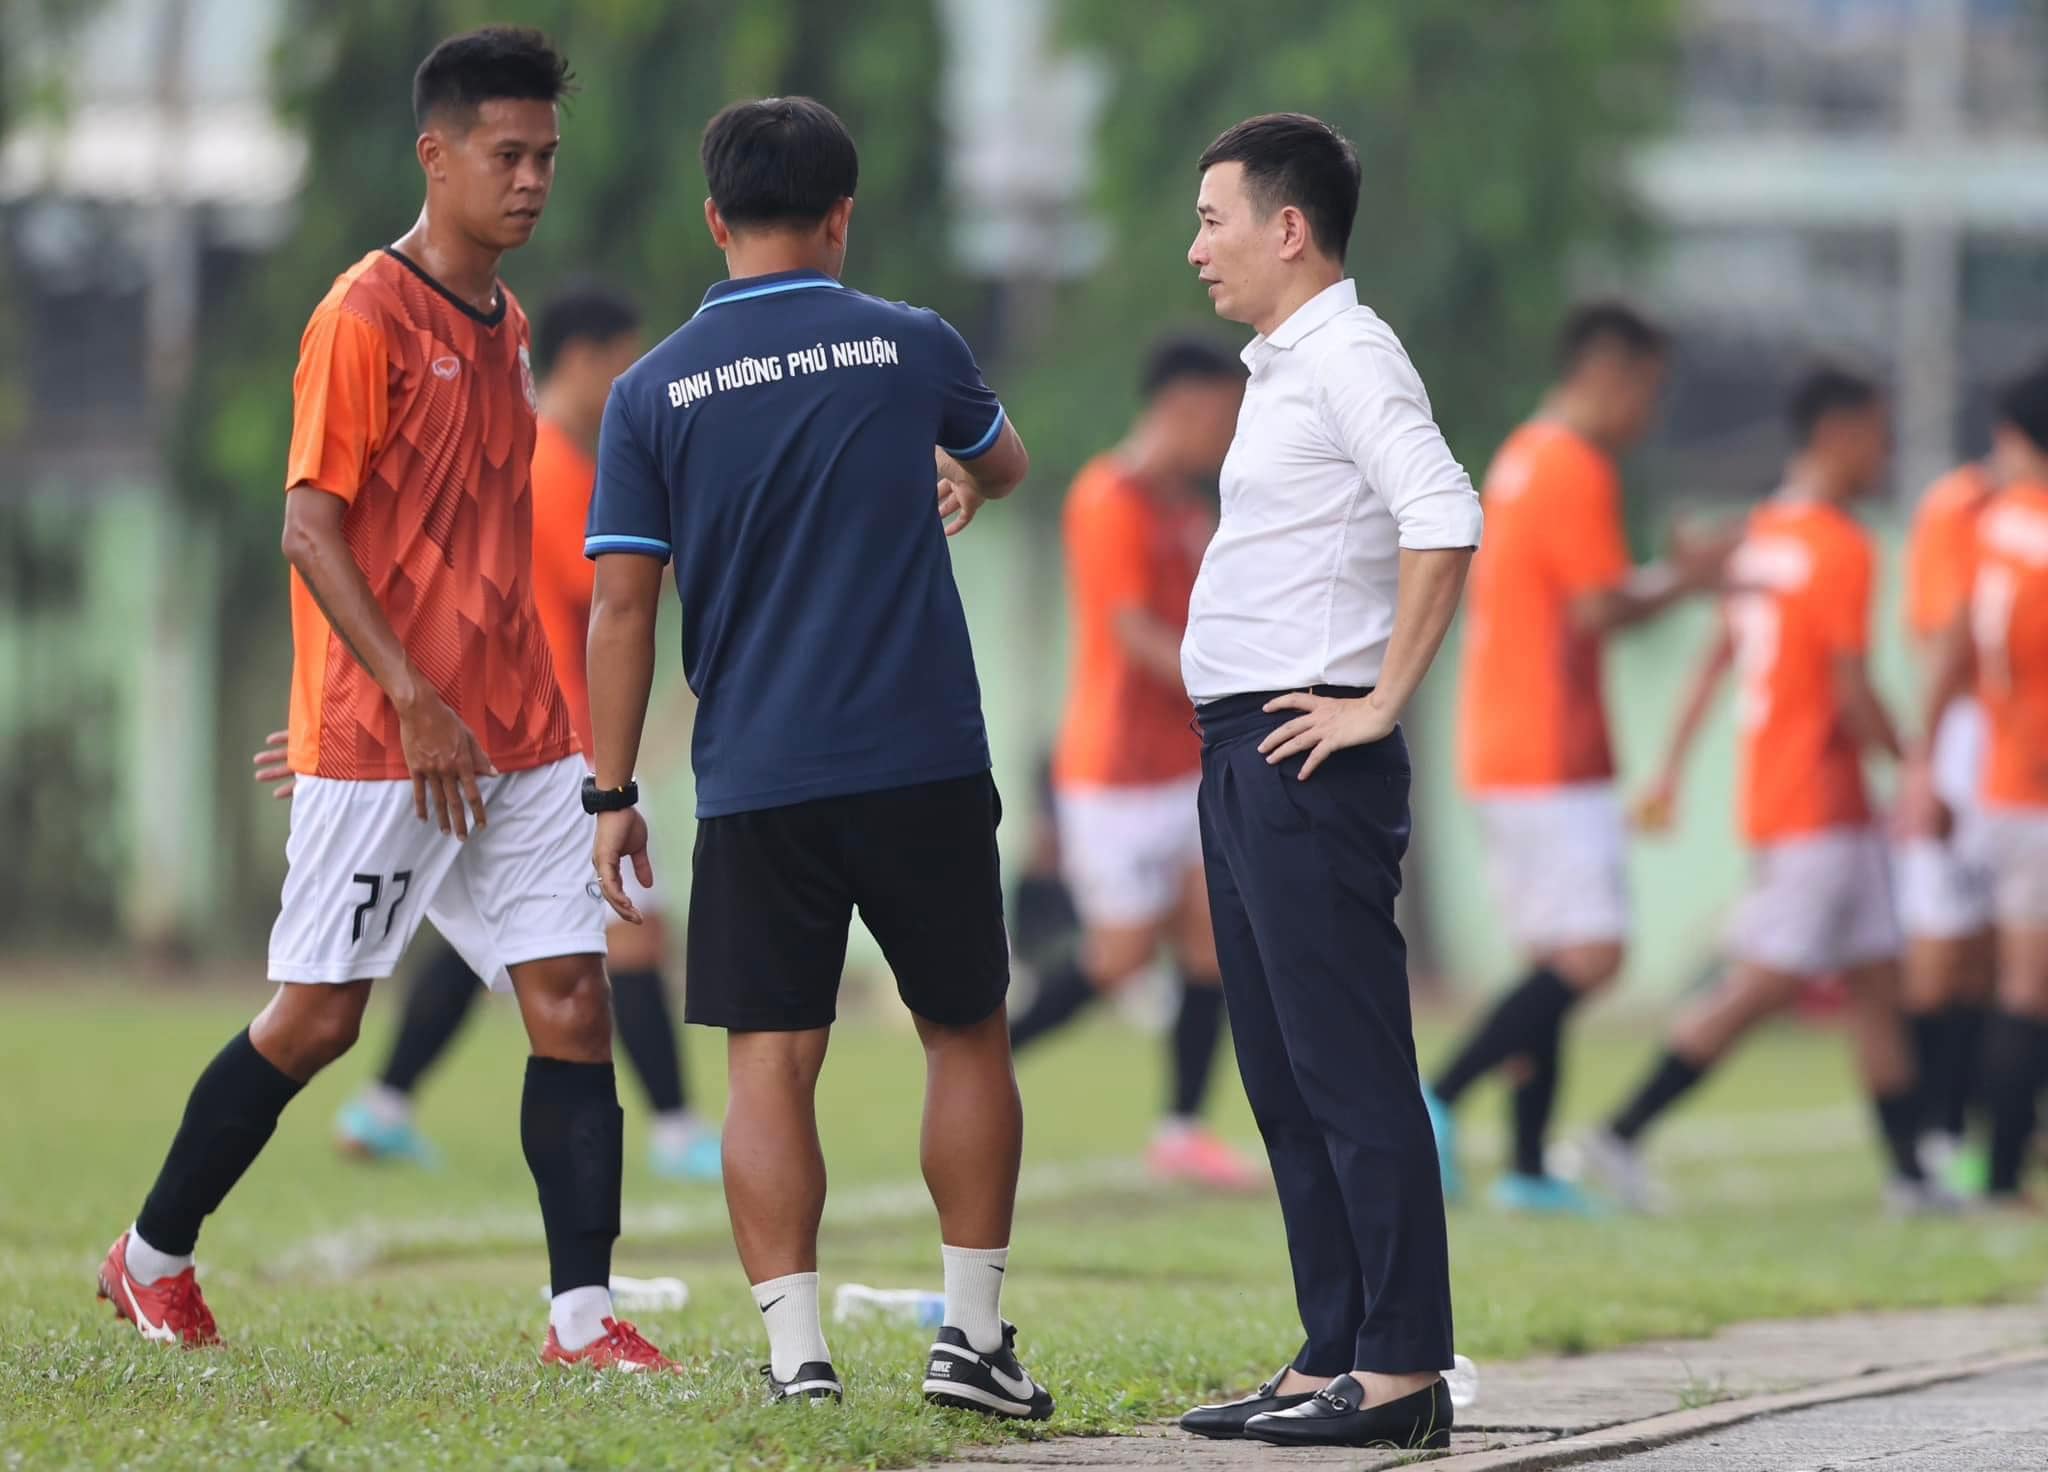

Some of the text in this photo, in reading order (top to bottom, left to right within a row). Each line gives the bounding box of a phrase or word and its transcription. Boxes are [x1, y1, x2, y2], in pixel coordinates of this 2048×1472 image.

[668, 370, 713, 409] ĐỊNH
[786, 342, 828, 377] PHÚ
[831, 336, 899, 368] NHUẬN
[352, 869, 412, 944] 77
